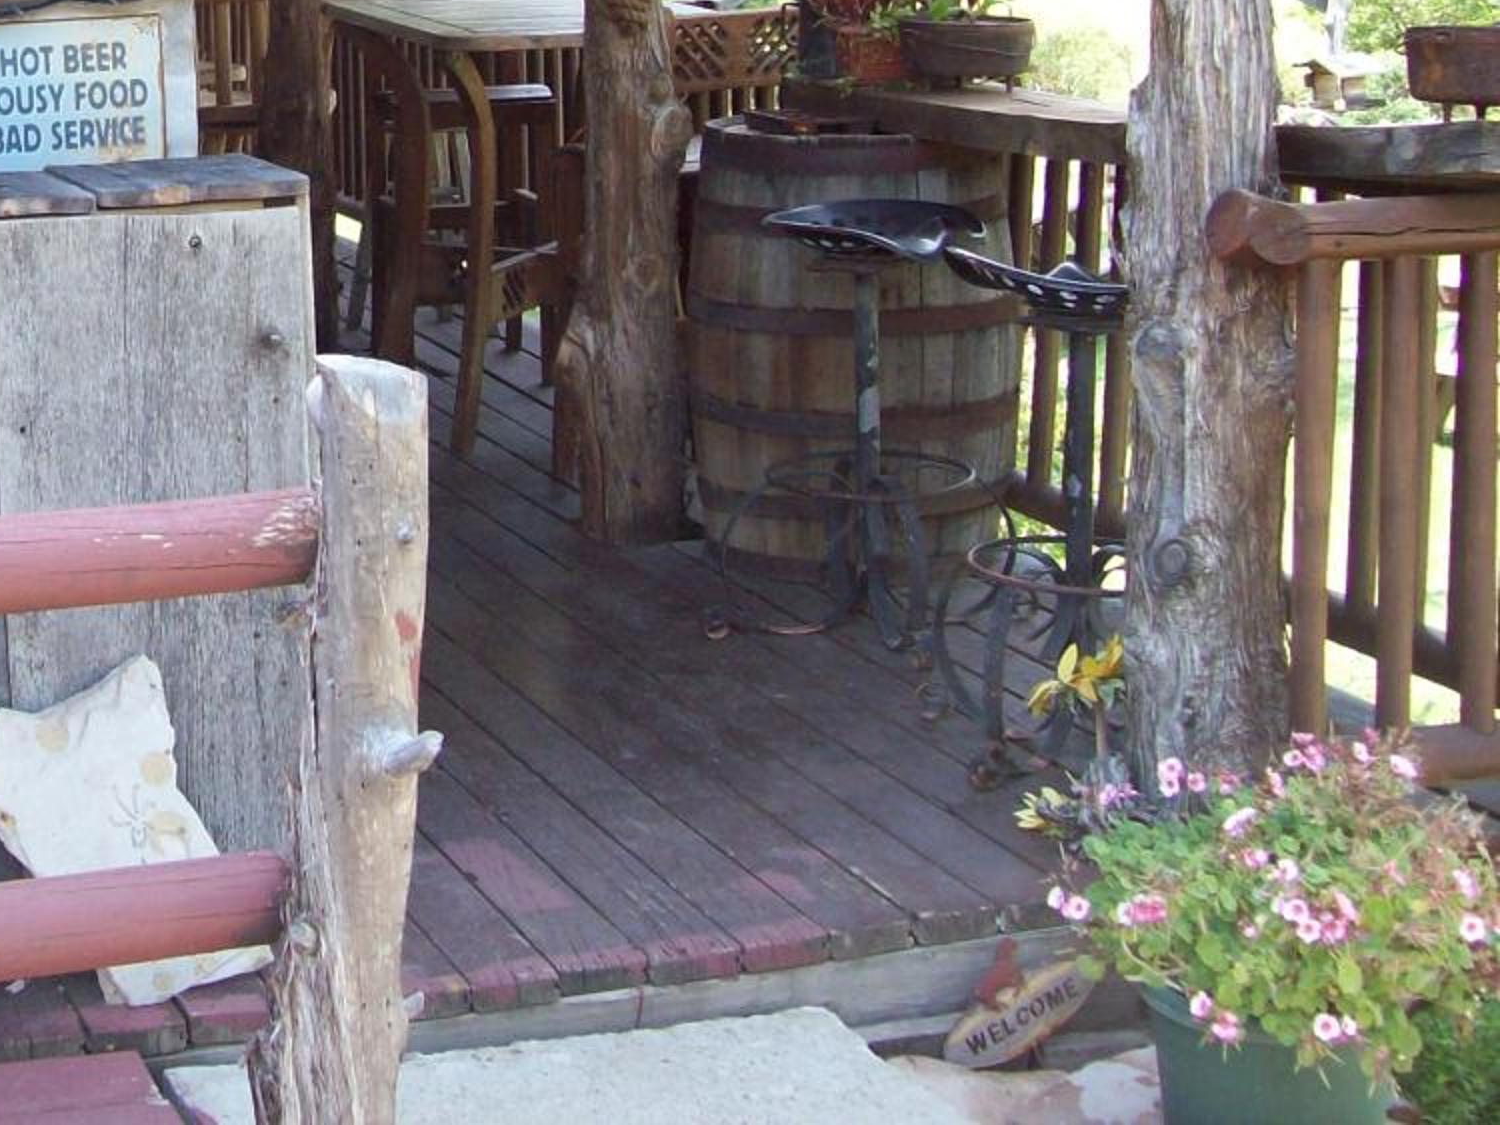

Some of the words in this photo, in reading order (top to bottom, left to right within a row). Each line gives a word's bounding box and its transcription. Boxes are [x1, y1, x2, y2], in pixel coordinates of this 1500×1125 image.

[0, 46, 53, 77] HOT
[63, 42, 127, 74] BEER
[74, 79, 148, 111] FOOD
[51, 116, 146, 151] SERVICE
[965, 976, 1079, 1055] WELCOME
